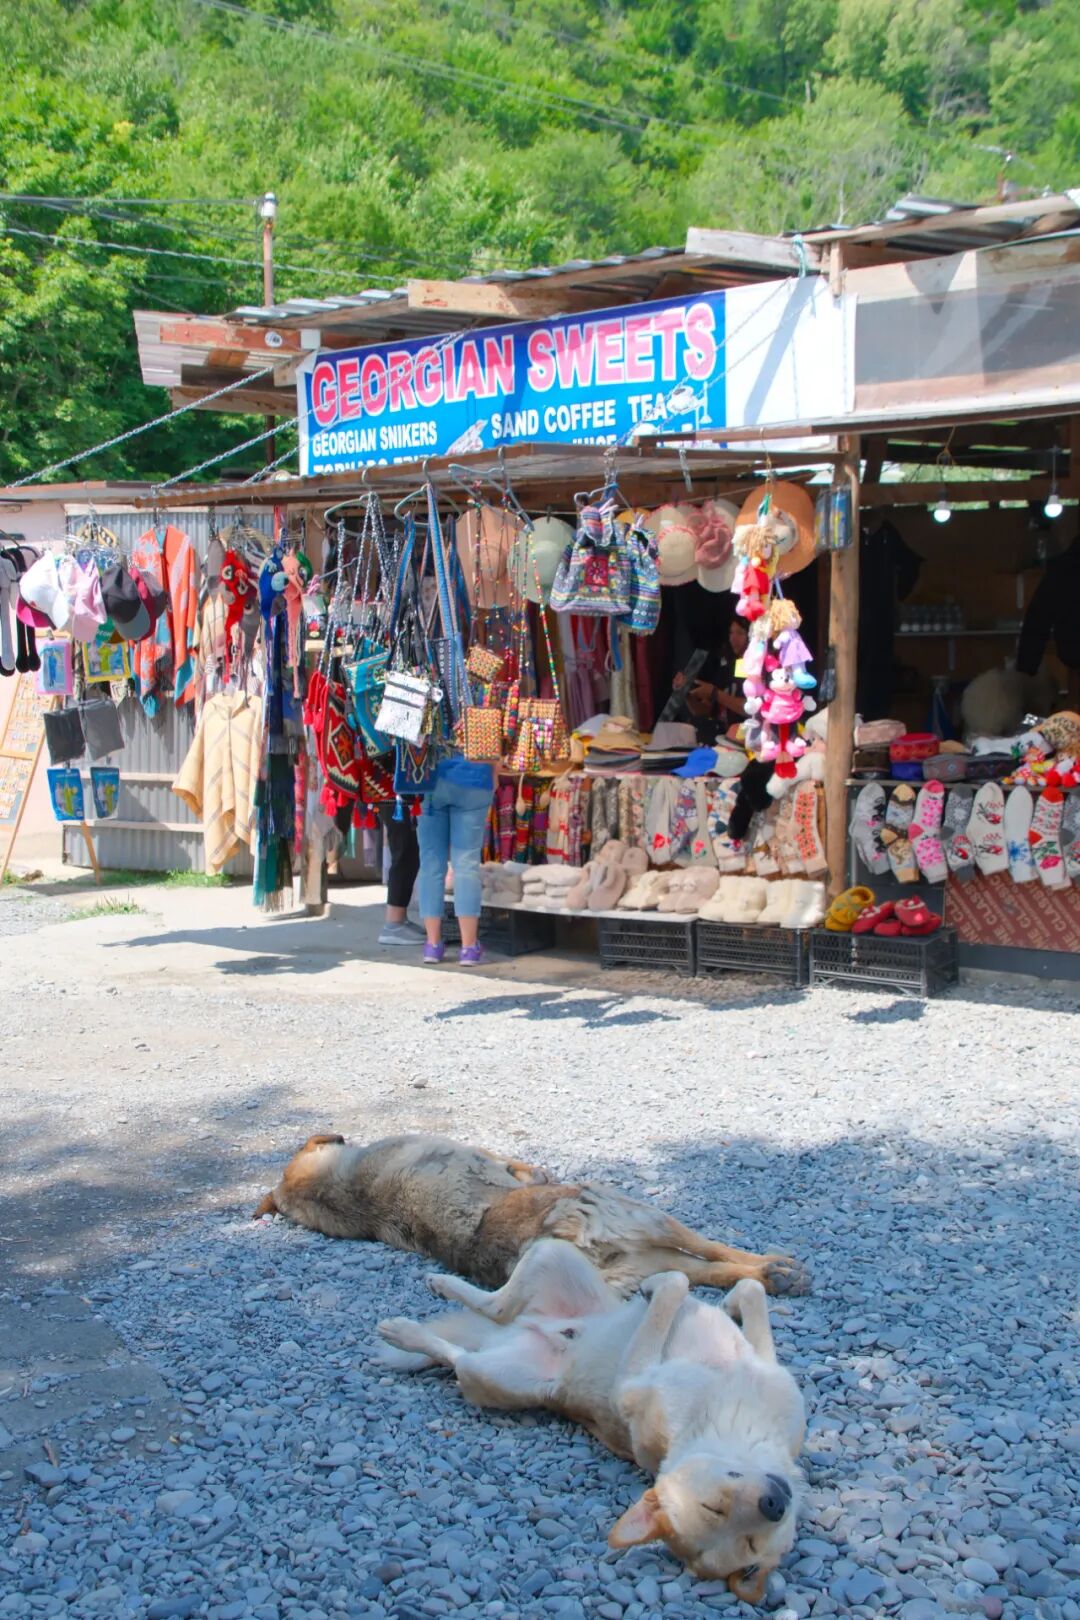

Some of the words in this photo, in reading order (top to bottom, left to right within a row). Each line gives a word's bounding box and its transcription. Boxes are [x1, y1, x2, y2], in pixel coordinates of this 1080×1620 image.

[312, 335, 515, 427] GEORGIAN
[527, 302, 717, 392] SWEETS
[312, 428, 377, 457] GEORGIAN
[380, 421, 438, 450] SNIKERS
[491, 409, 539, 440] SAND
[544, 399, 616, 433] COFFEE
[628, 392, 668, 423] TEA
[961, 880, 998, 925] CLASSI
